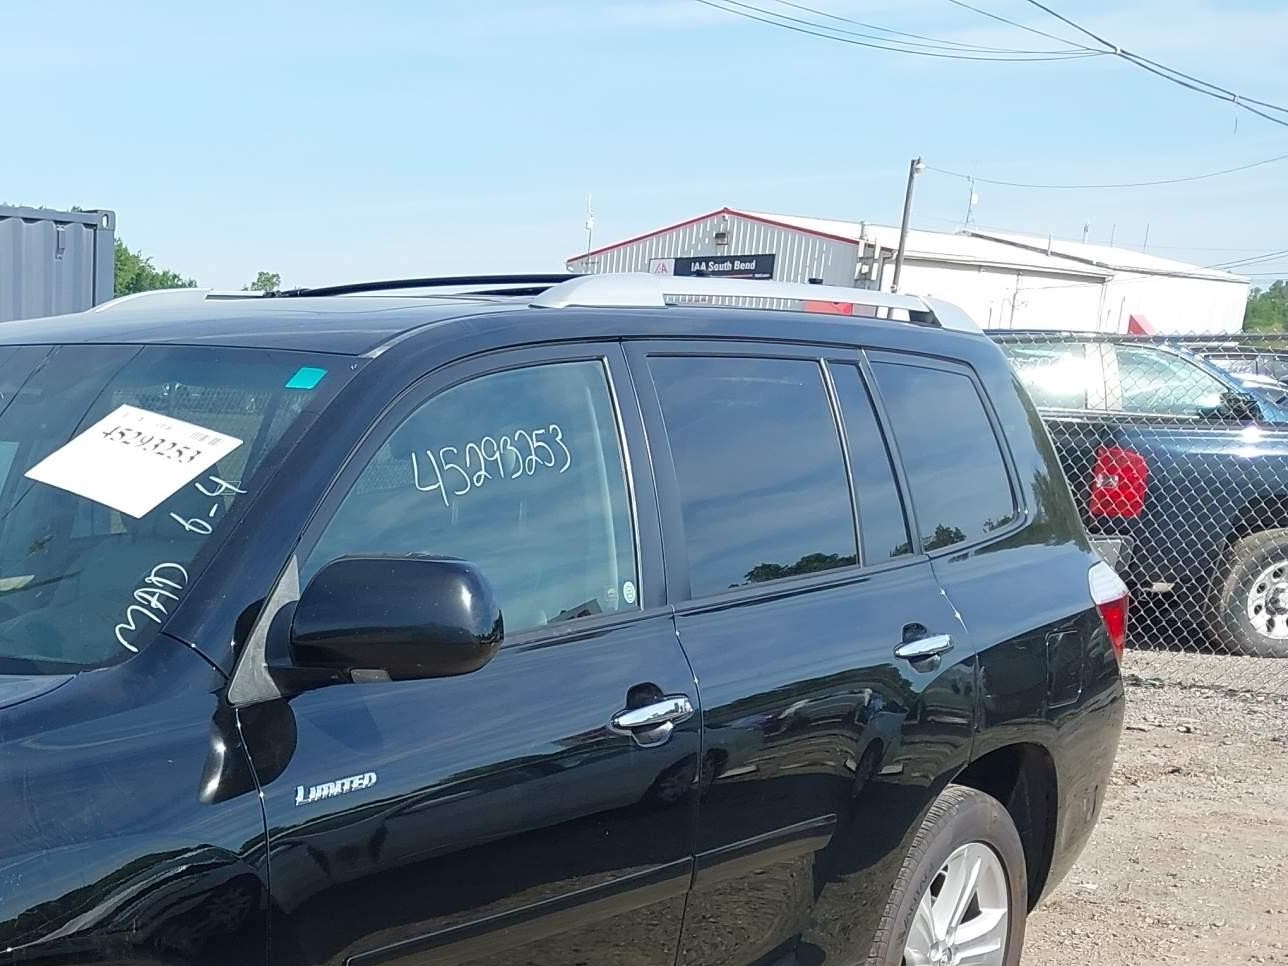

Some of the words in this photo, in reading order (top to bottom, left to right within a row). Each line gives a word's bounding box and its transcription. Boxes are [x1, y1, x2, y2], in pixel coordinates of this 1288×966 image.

[691, 261, 706, 272] IAA
[708, 261, 732, 272] South
[734, 260, 756, 270] Bend
[102, 425, 202, 464] 45293253
[412, 425, 571, 506] 45293253
[170, 476, 247, 534] 6-4
